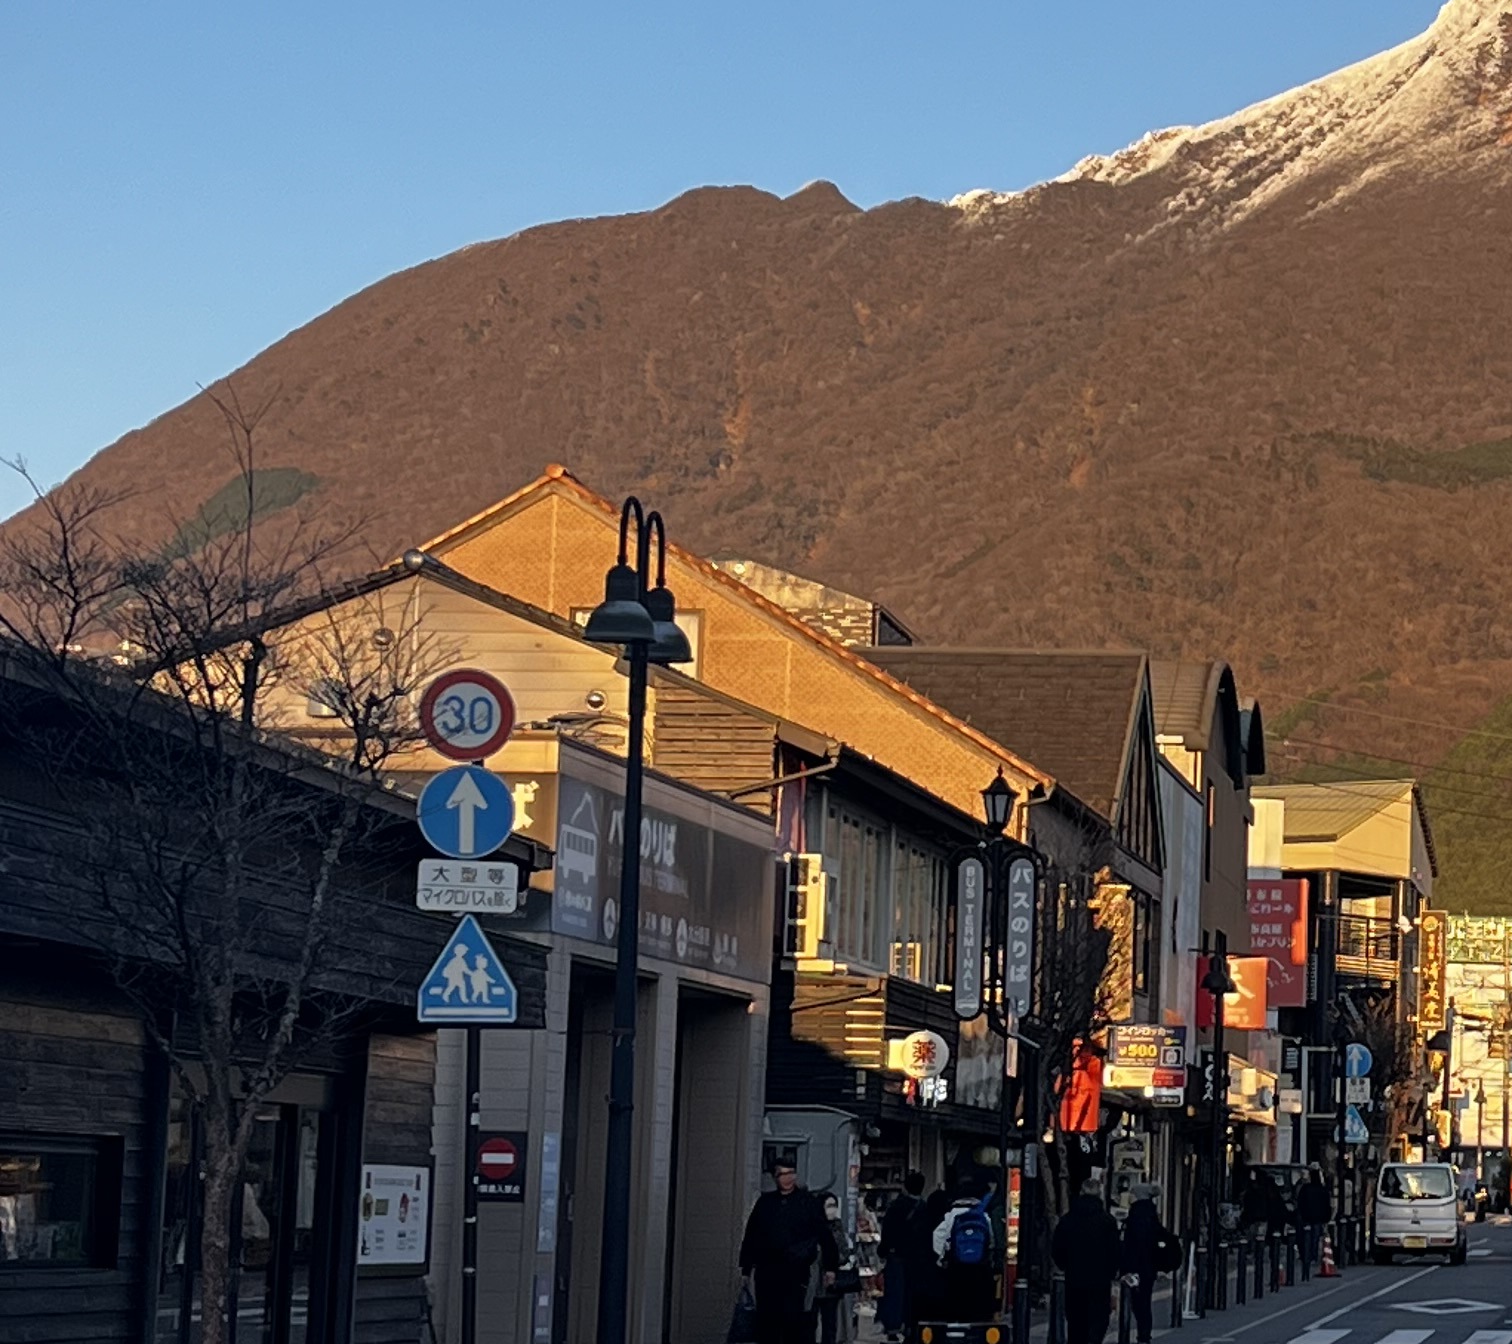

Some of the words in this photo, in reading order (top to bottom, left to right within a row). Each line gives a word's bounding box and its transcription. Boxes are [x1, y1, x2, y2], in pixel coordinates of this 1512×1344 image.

[443, 696, 493, 734] 30
[608, 809, 677, 867] バのりば
[431, 865, 505, 885] 大型等
[965, 865, 977, 900] BUS
[421, 888, 512, 908] マイクロバスを除く
[1009, 867, 1032, 983] バスのりば
[963, 903, 977, 992] TERMINAL
[912, 1039, 937, 1064] 薬
